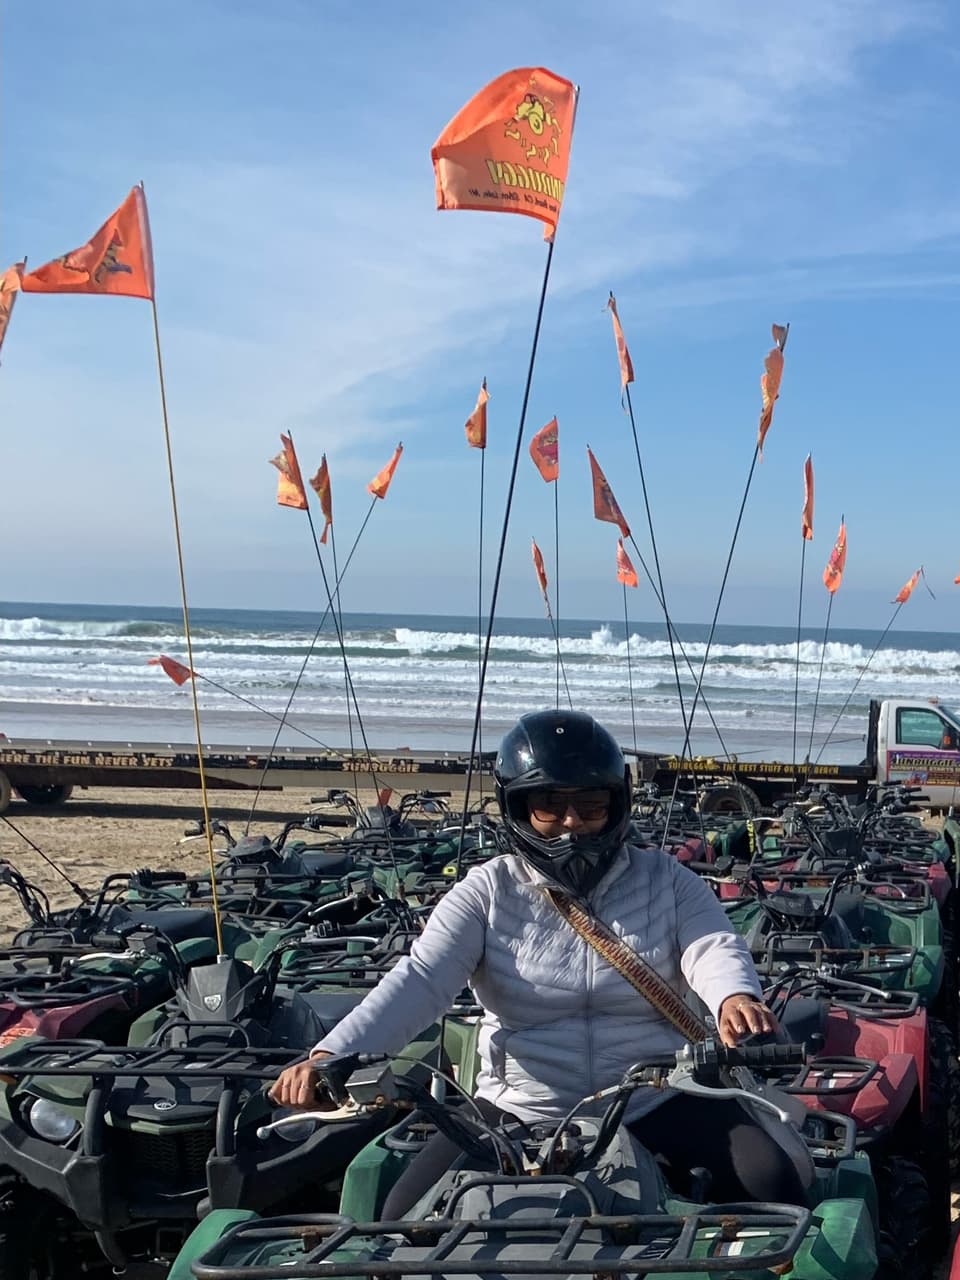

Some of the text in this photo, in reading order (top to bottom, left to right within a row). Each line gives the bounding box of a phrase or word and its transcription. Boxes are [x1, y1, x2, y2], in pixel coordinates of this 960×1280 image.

[0, 753, 30, 764] HERE
[36, 754, 59, 764] THE
[63, 755, 91, 765] FUN
[95, 756, 138, 767] NEVER
[342, 762, 420, 773] SUNBUGGIE
